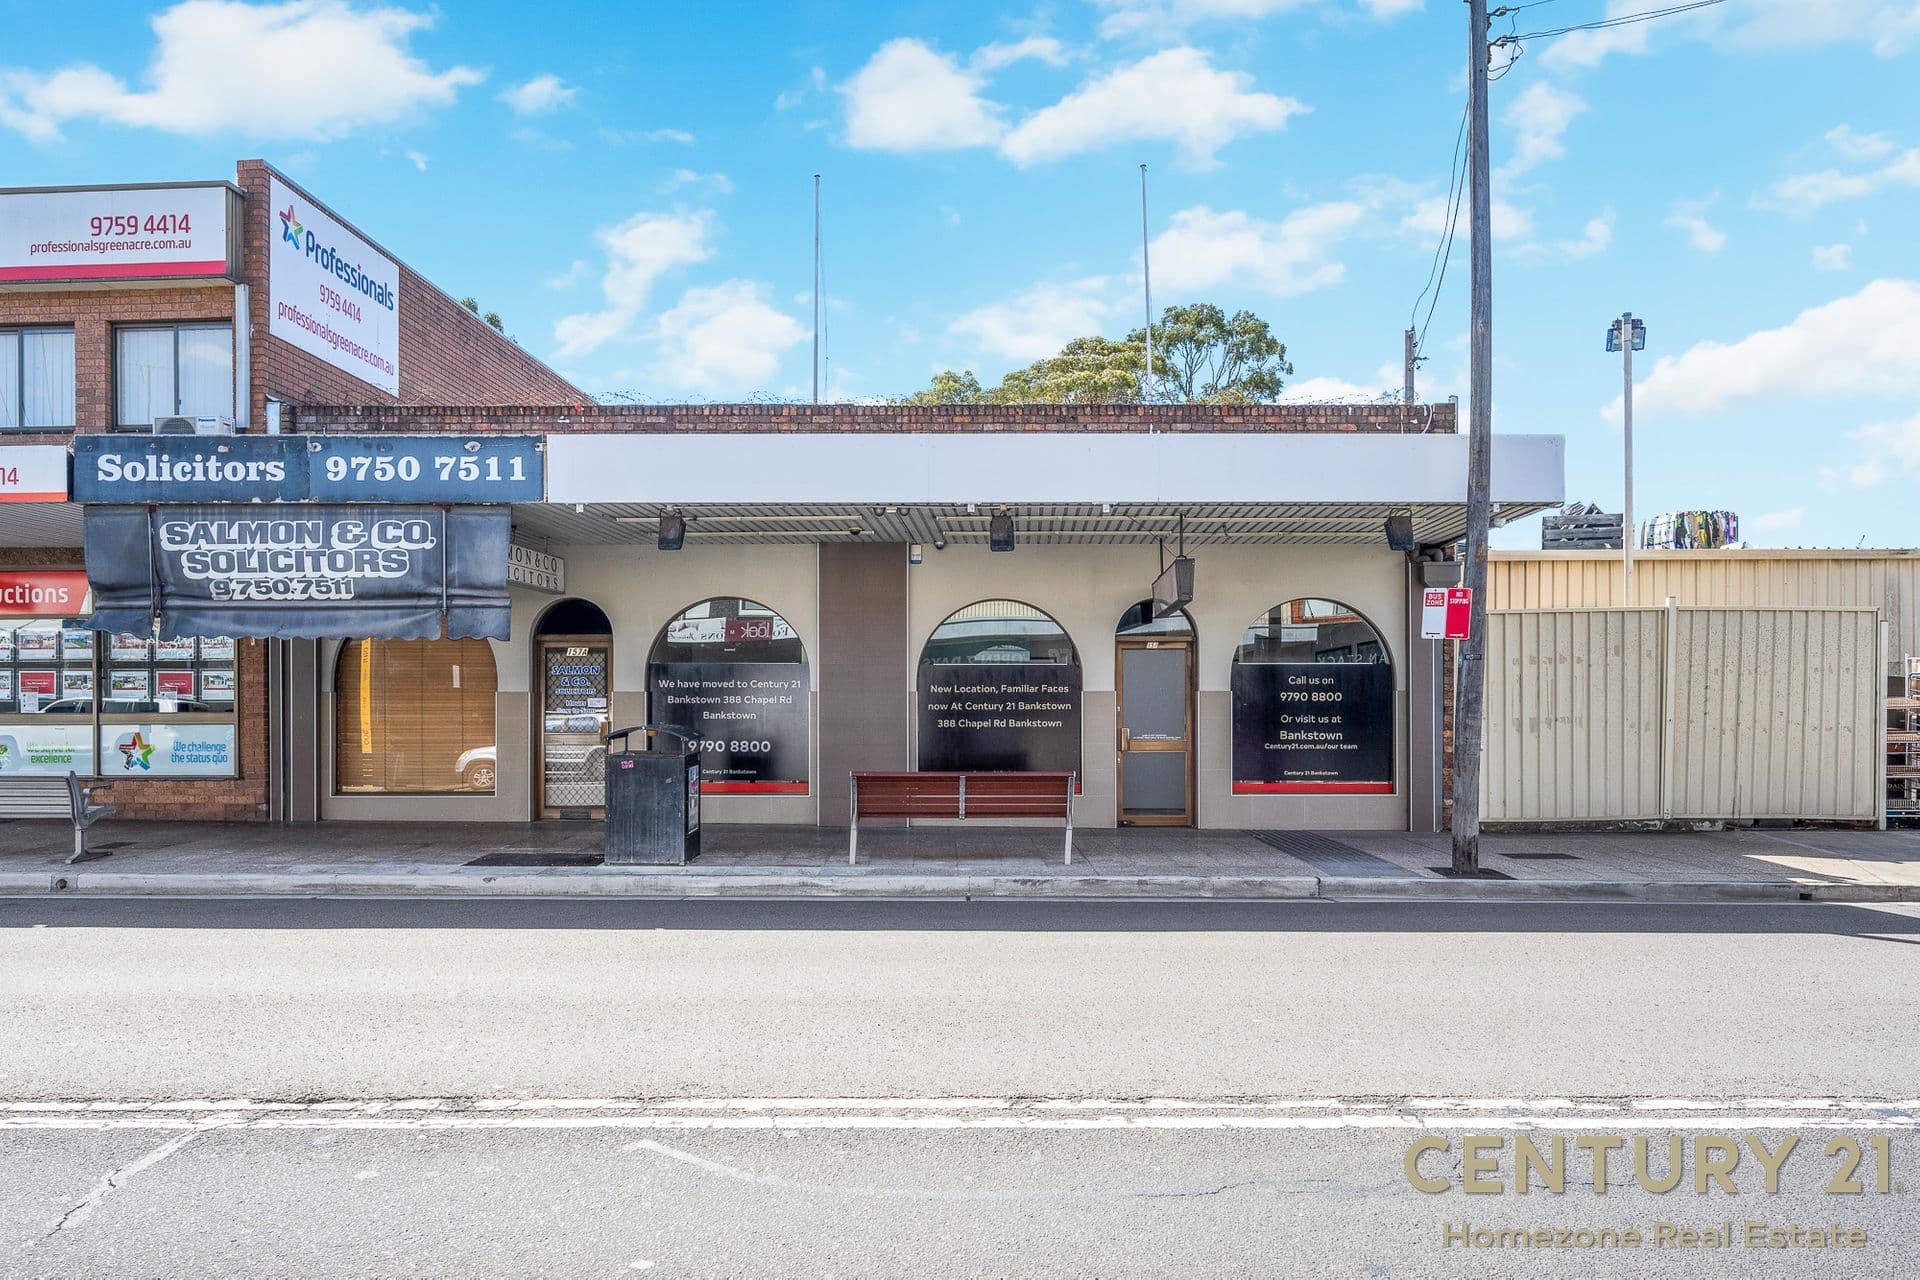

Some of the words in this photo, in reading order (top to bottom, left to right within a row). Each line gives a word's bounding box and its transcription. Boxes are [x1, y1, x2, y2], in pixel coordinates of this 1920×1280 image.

[90, 215, 138, 236] 9759
[143, 214, 191, 235] 4414
[30, 238, 191, 256] professionalsgreenacre.com.au
[305, 230, 394, 311] Professionals
[319, 284, 341, 312] 9759
[341, 299, 362, 324] 4414
[278, 301, 394, 376] professionalsgreenacre.com.au
[97, 454, 286, 482] Solicitors
[325, 456, 420, 482] 9750
[434, 456, 526, 481] 7511
[160, 520, 323, 550] SALMON
[331, 520, 368, 549] &
[371, 520, 437, 549] CO.
[181, 550, 409, 579] SOLICITORS
[0, 584, 69, 604] ctions
[551, 665, 600, 675] SALMON
[560, 677, 569, 687] &
[658, 680, 675, 688] We
[677, 680, 700, 688] have
[702, 680, 735, 688] moved
[750, 680, 789, 690] Century
[791, 680, 801, 688] 21
[1288, 676, 1307, 685] Call
[930, 685, 951, 693] New
[954, 684, 999, 694] Location,
[1001, 684, 1039, 693] Familiar
[1041, 684, 1069, 693] Faces
[667, 695, 721, 704] Bankstown
[723, 696, 741, 704] 388
[744, 695, 777, 706] Chapel
[779, 695, 793, 704] Rd
[1280, 692, 1308, 702] 9790
[1311, 692, 1342, 702] 8800
[951, 702, 962, 710] At
[965, 702, 1003, 712] Century
[1006, 702, 1016, 710] 21
[1018, 702, 1072, 710] Bankstown
[703, 711, 757, 720] Bankstown
[1280, 715, 1294, 723] Or
[1295, 715, 1316, 724] visit
[1318, 716, 1329, 724] us
[1331, 715, 1342, 723] at
[937, 719, 956, 728] 388
[958, 719, 992, 730] Chapel
[993, 719, 1007, 728] Rd
[1009, 719, 1062, 728] Bankstown
[1280, 730, 1343, 740] Bankstown
[173, 741, 187, 751] We
[187, 741, 226, 755] challenge
[688, 740, 726, 752] 9790
[730, 740, 771, 752] 8800
[1264, 742, 1339, 751] Century21.com.au/our
[30, 754, 72, 764] excellence
[171, 753, 185, 763] the
[186, 753, 211, 763] status
[212, 754, 228, 764] quo
